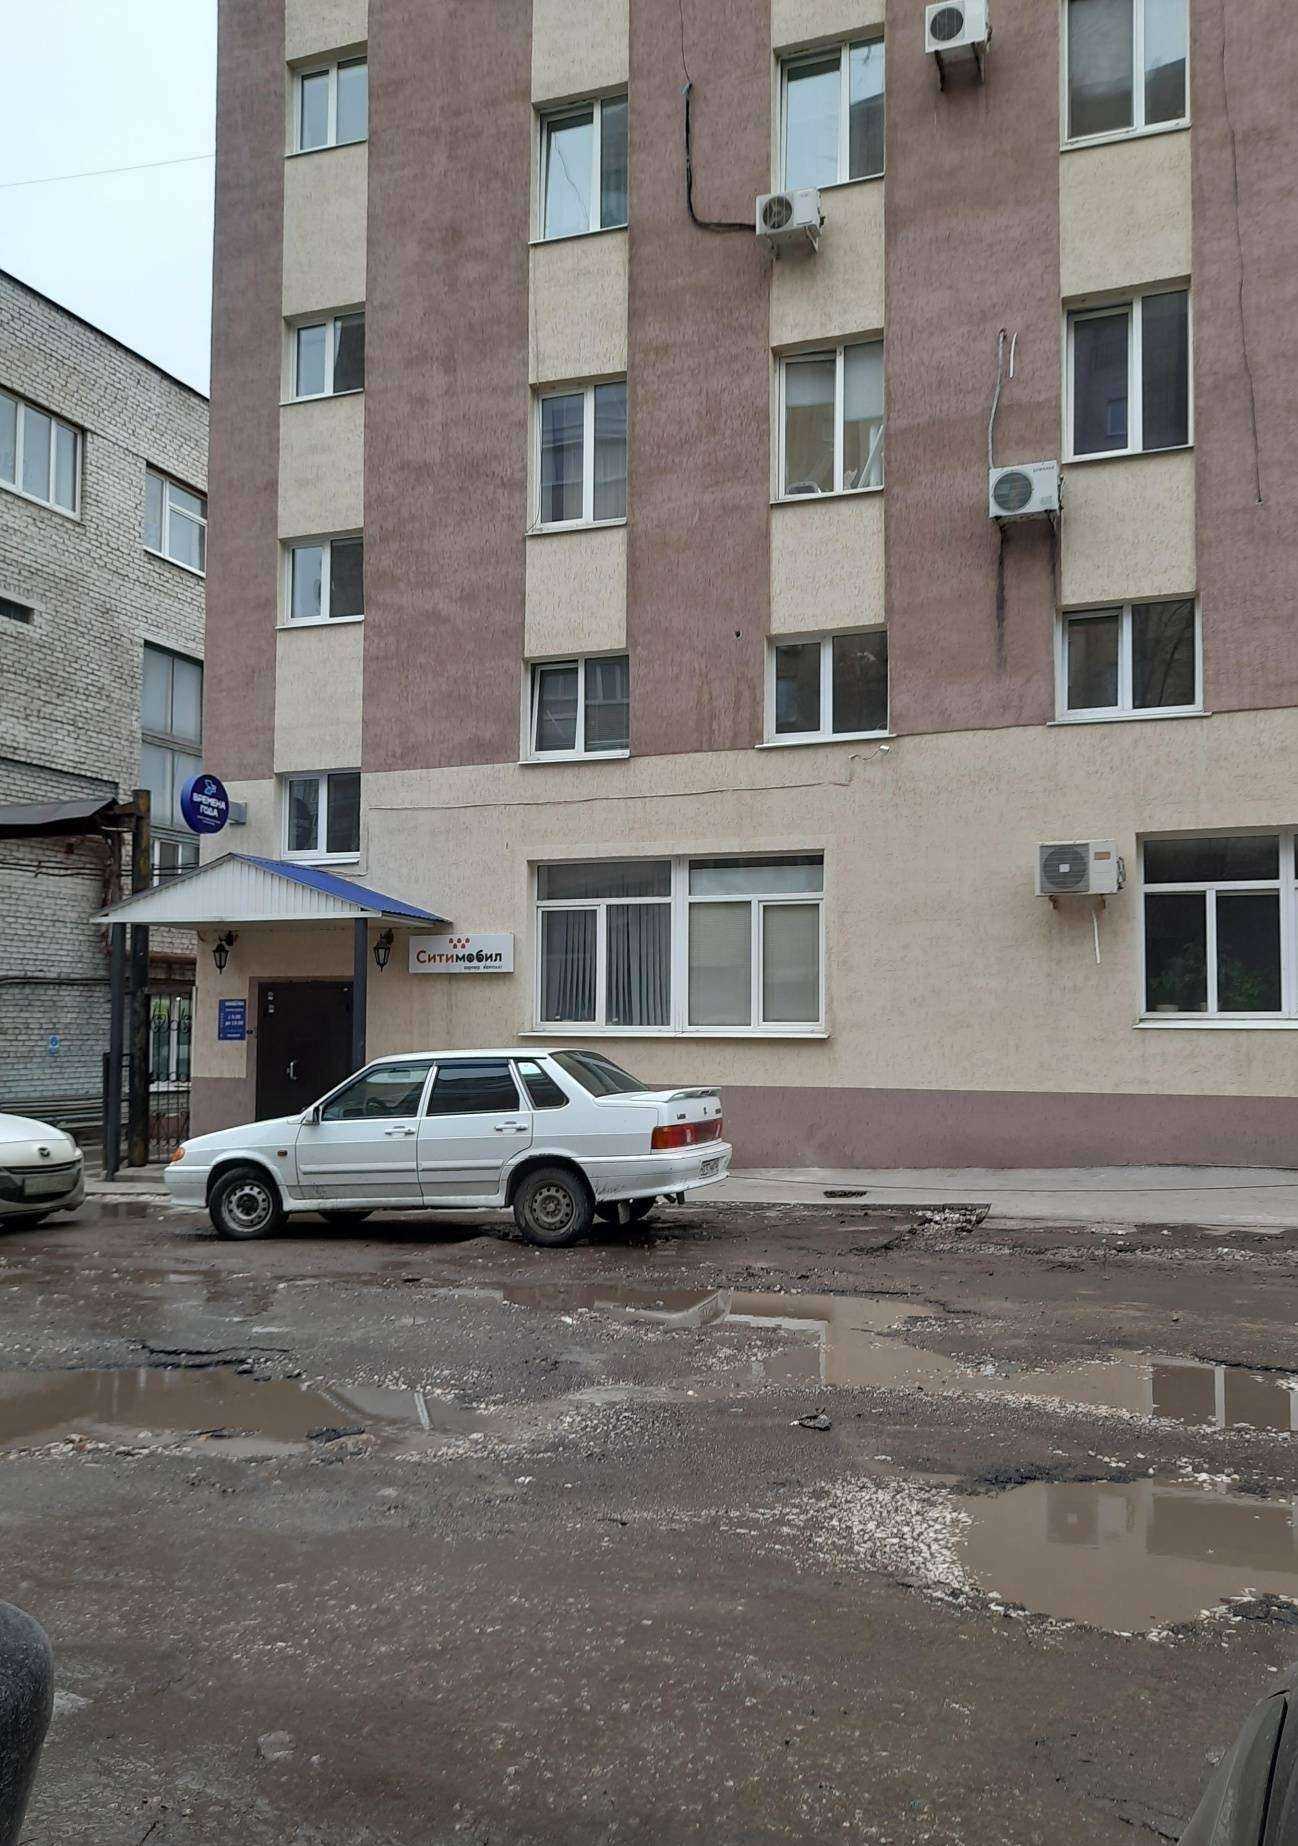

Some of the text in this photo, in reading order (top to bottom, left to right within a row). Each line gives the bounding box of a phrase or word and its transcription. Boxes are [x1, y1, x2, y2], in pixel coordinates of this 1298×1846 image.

[192, 792, 226, 810] ВРЕМЕНА
[200, 805, 218, 817] ГОДА
[416, 949, 502, 964] Ситимобил
